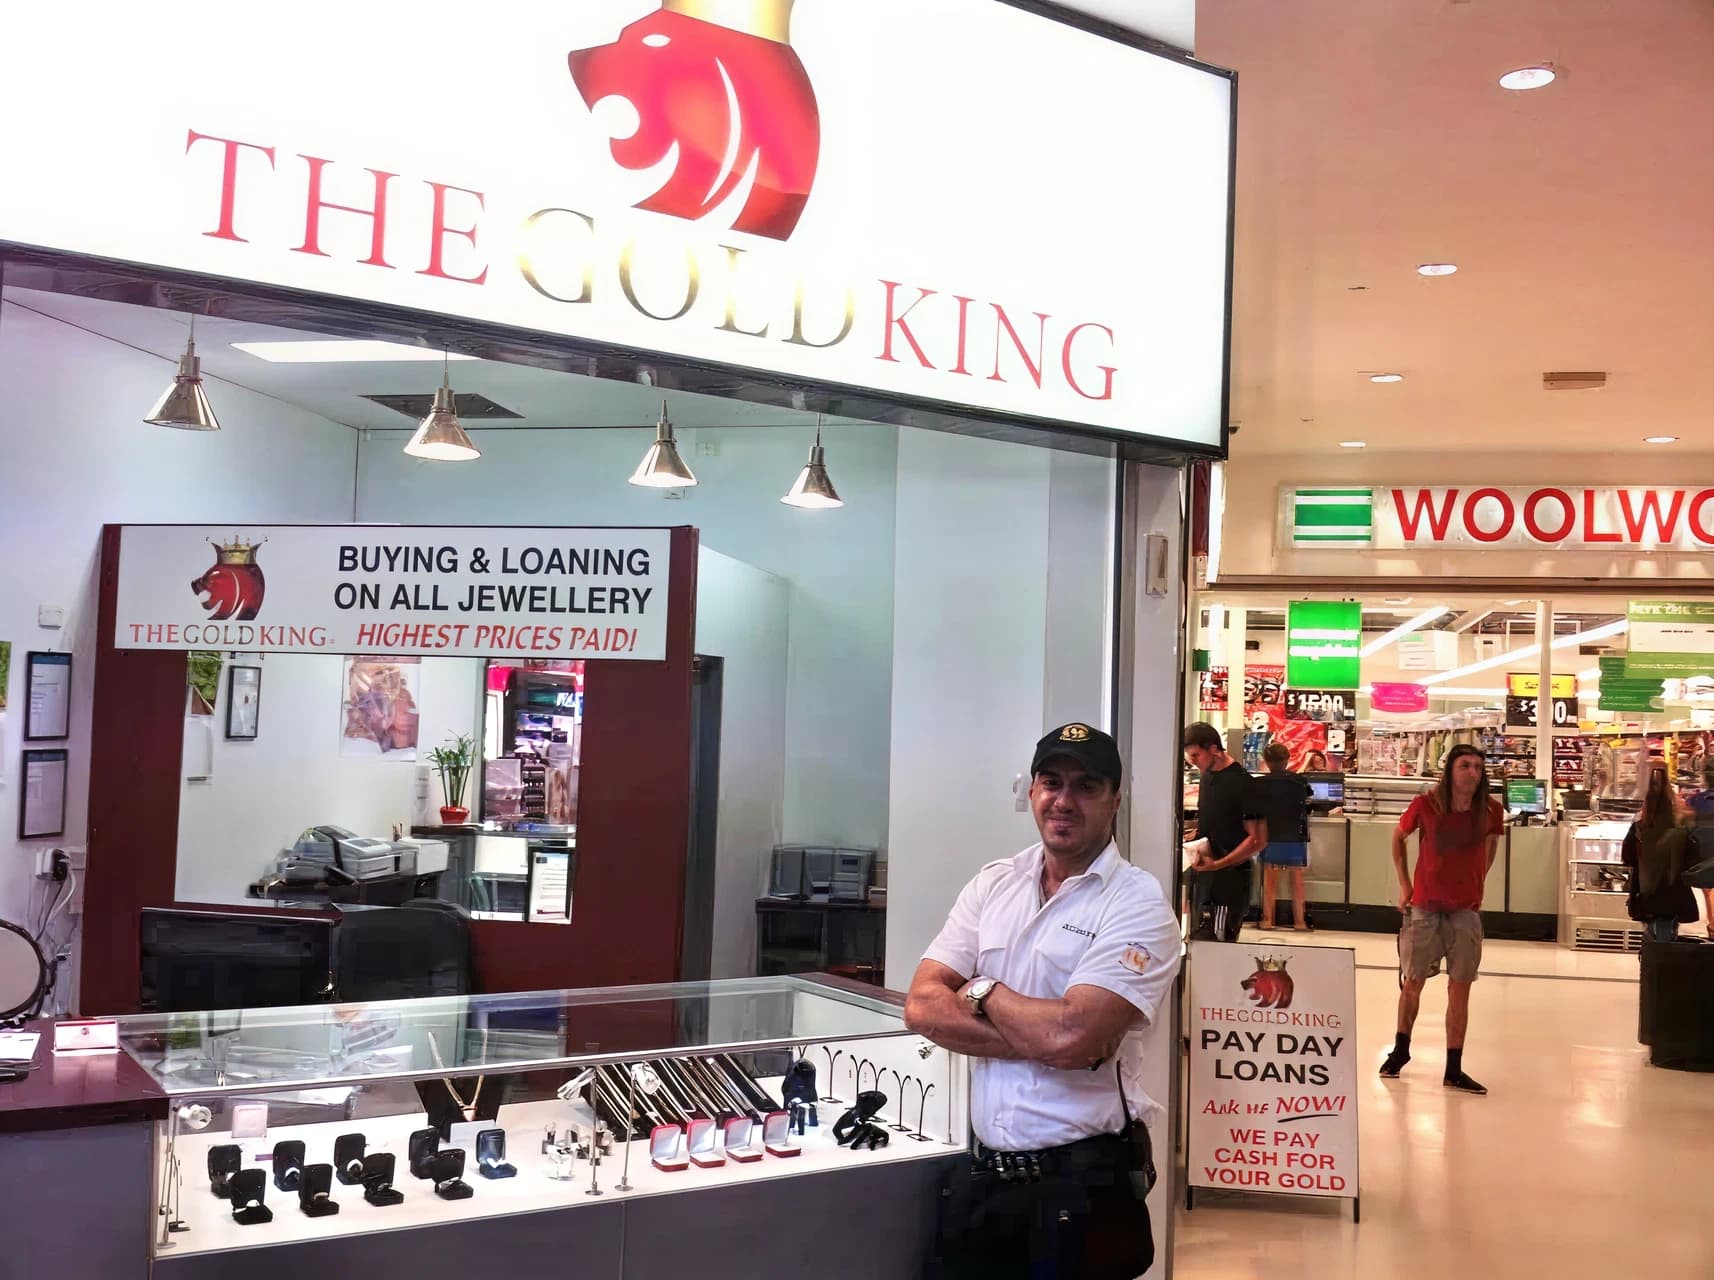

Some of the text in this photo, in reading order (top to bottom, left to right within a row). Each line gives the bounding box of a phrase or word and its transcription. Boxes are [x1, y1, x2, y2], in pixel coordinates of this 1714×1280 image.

[338, 545, 650, 576] BUYING & LOANING
[334, 582, 653, 615] ON ALL JEWELLERY
[356, 623, 637, 653] HIGHEST PRICES PAID!
[1201, 1029, 1344, 1057] PAY DAY
[1215, 1059, 1330, 1086] LOANS
[1229, 1128, 1320, 1149] WE PAY
[1213, 1148, 1336, 1170] CASH FOR
[1204, 1166, 1347, 1192] YOUR GOLD
